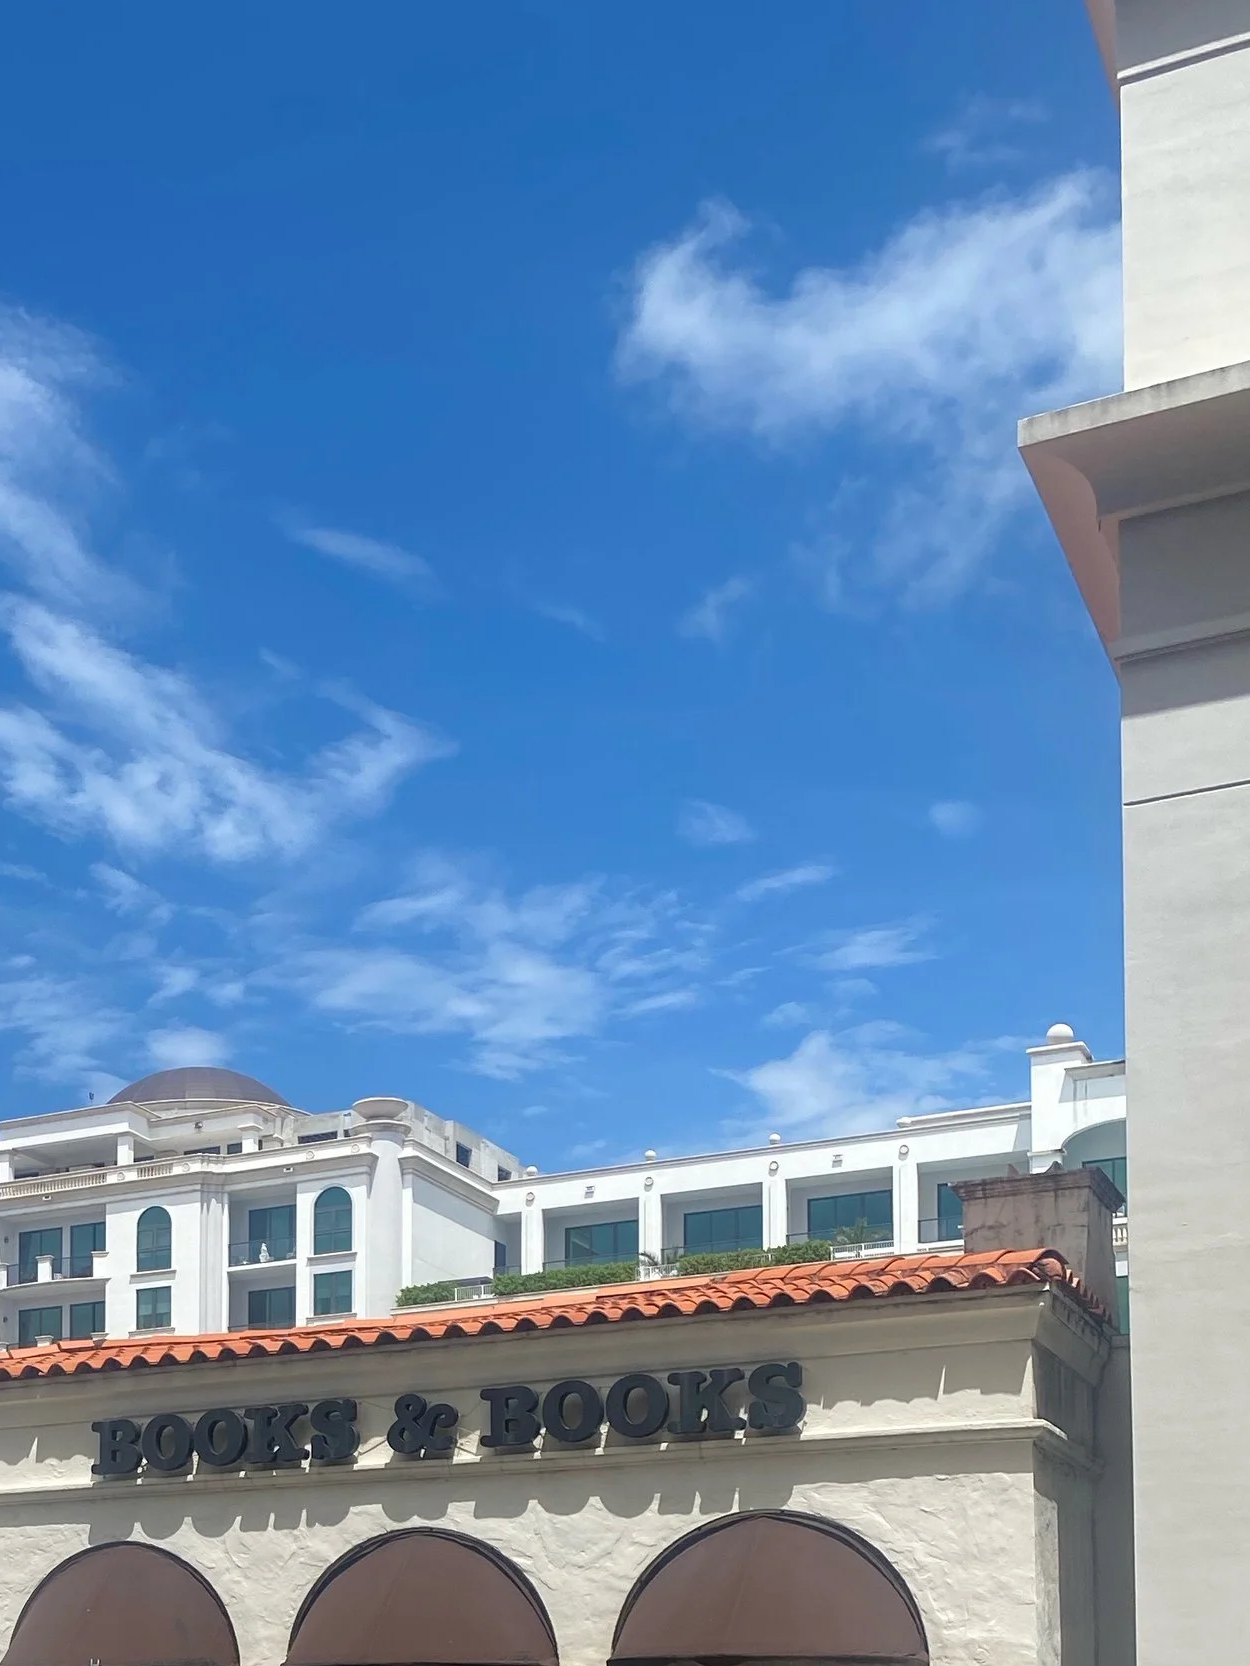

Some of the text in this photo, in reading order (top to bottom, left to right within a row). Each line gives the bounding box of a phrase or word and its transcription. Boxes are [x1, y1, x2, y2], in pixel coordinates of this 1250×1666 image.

[91, 1362, 806, 1476] BOOKS & BOOKS
